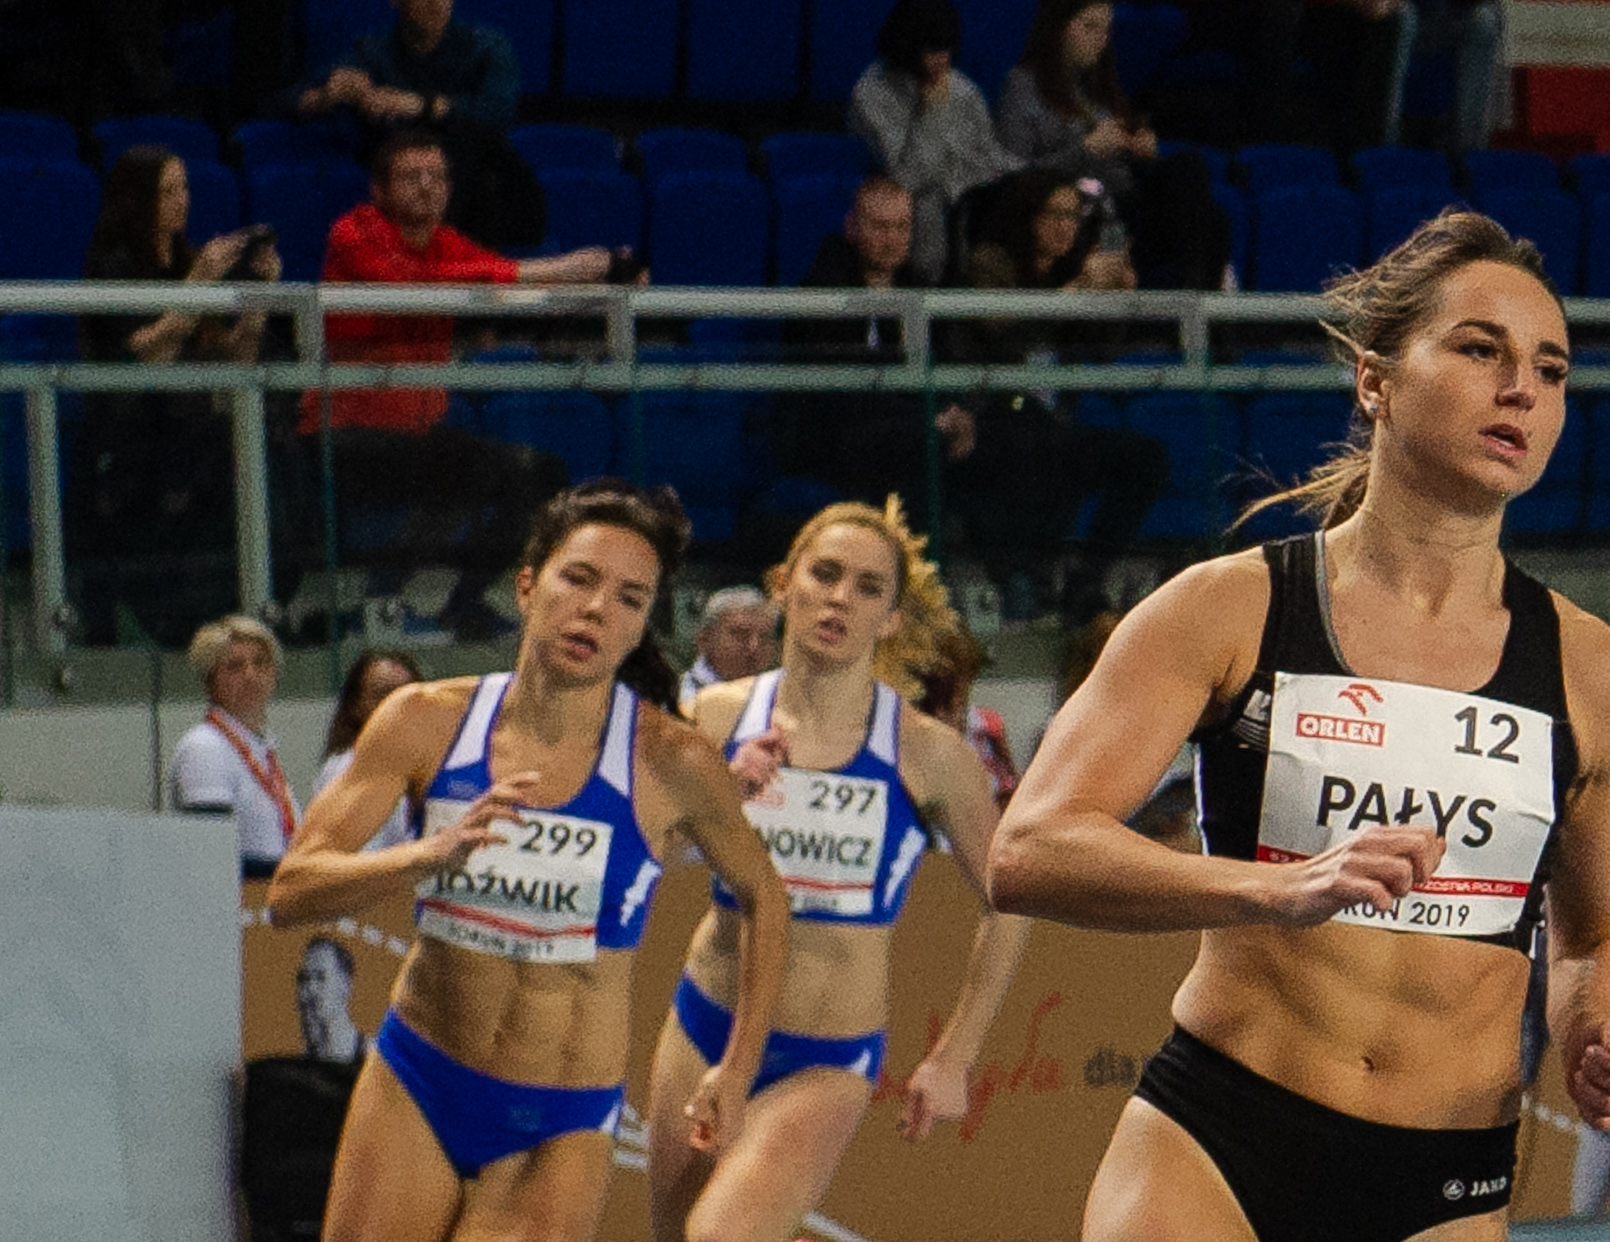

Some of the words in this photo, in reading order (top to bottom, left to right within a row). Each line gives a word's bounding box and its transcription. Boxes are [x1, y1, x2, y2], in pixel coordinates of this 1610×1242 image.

[1300, 715, 1381, 744] ORLEN
[1454, 706, 1520, 764] 12
[809, 779, 877, 815] 297
[1316, 775, 1497, 848] PAŁYS
[520, 820, 598, 857] 299
[1409, 902, 1470, 927] 2019
